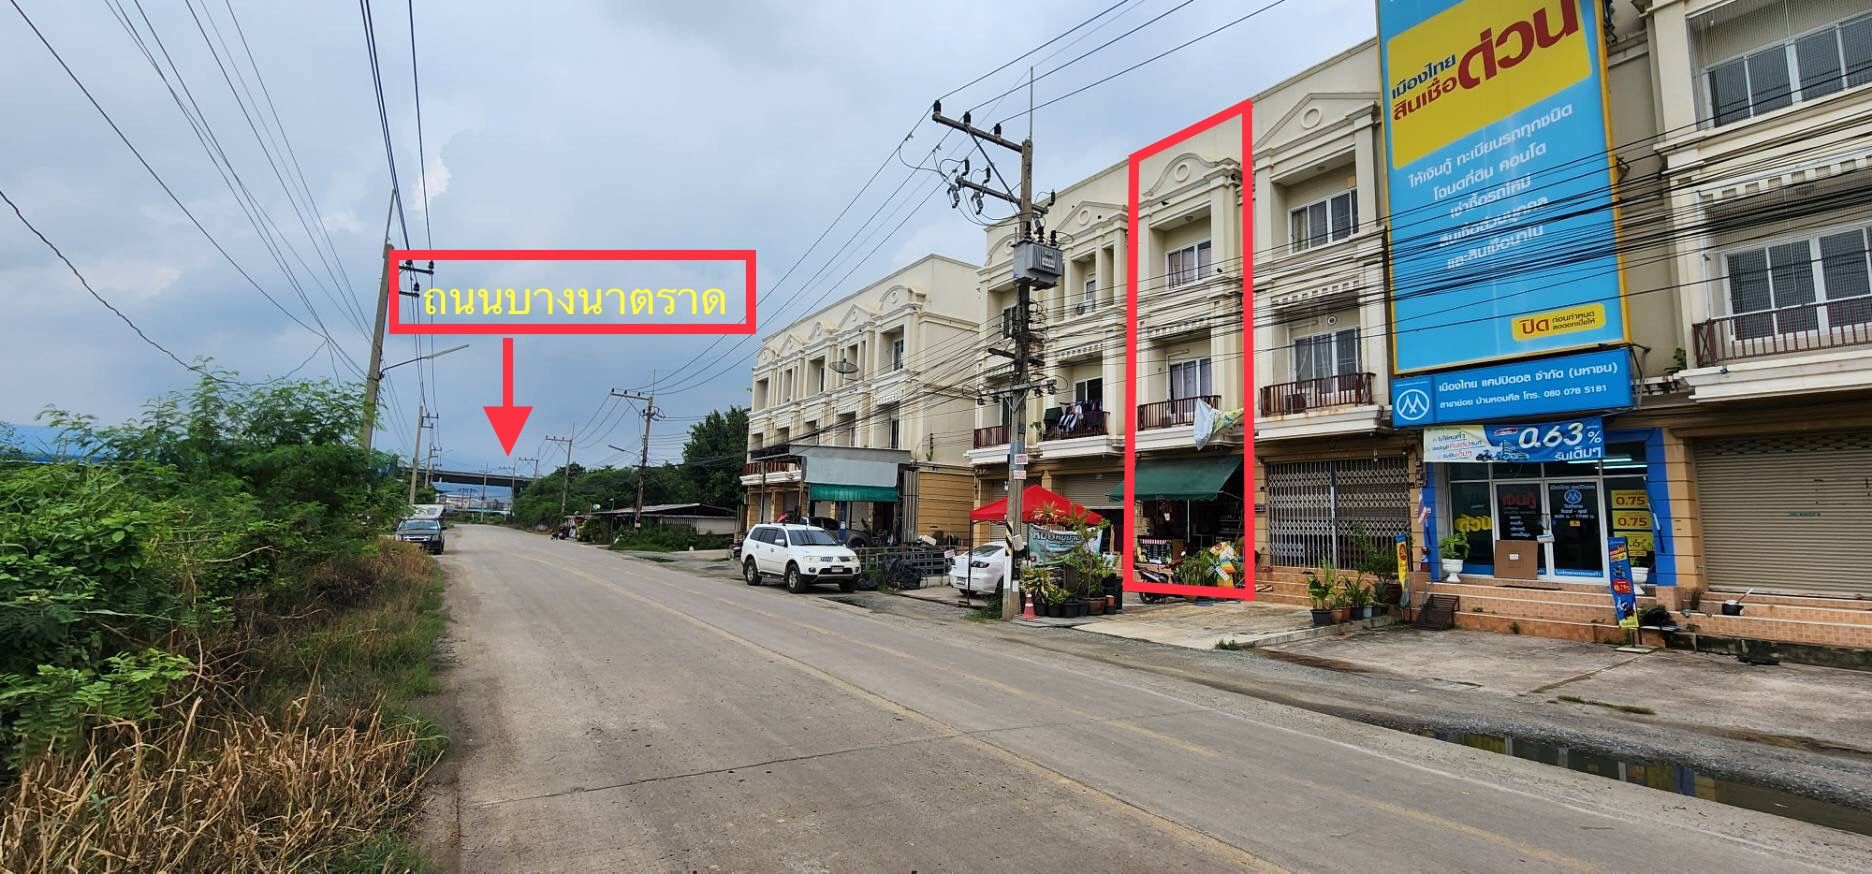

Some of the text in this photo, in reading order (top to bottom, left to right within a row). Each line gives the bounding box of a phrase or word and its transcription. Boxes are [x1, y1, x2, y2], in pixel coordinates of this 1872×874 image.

[1458, 0, 1580, 90] ด่วน
[1392, 54, 1456, 99] เมืองไทย
[1393, 77, 1457, 121] สินเชื่อ
[1408, 103, 1573, 188] ให้เงินกู้ ทะเบียนรถทุกชนิด
[1433, 141, 1547, 201] โฉนดที่ดิน คอนโด
[1519, 318, 1550, 335] ปิด
[1438, 362, 1618, 393] เมืองไทย แคปปิตอล จำกัด (มหาชน)
[1523, 389, 1541, 401] โทร.
[1543, 389, 1561, 398] 080
[1563, 387, 1581, 396] 078
[1584, 384, 1607, 394] 5181
[1518, 422, 1584, 449] 0.63
[1587, 431, 1602, 444] %
[1616, 496, 1646, 506] 0.75
[1617, 516, 1648, 527] 0.75
